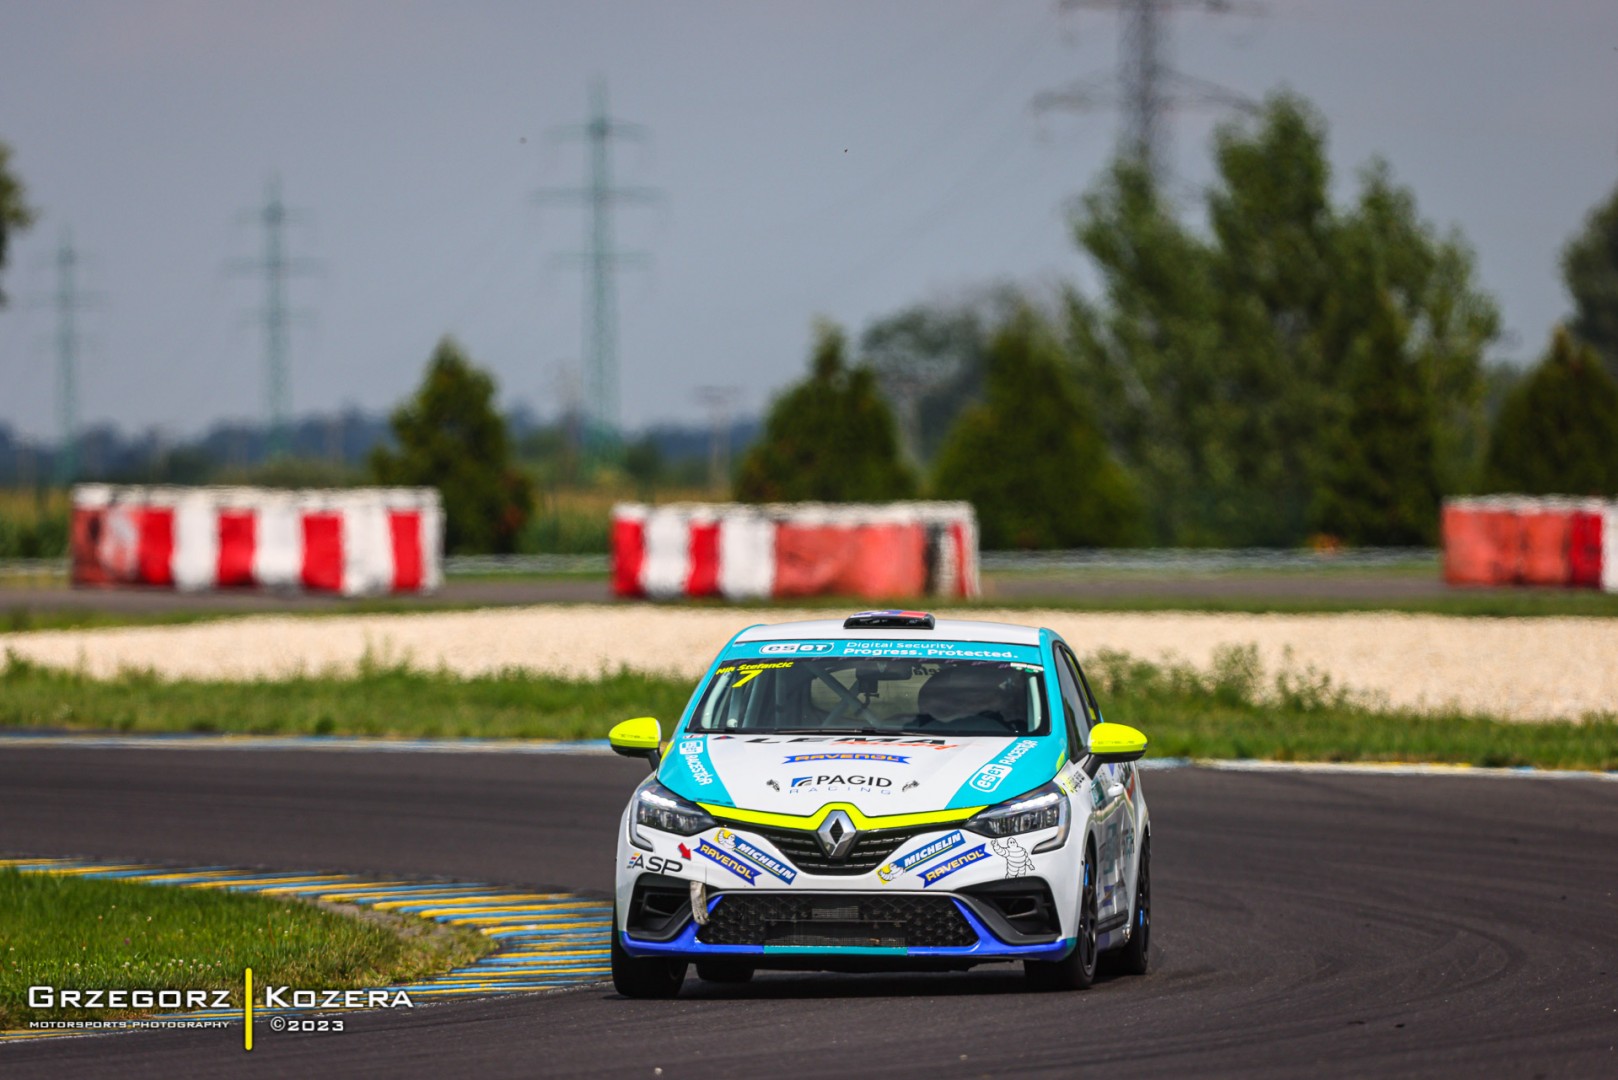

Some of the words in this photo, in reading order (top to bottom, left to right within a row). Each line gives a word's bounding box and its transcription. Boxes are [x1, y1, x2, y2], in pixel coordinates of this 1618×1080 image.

[843, 648, 923, 656] Progress.
[927, 649, 1018, 658] Protected.
[732, 669, 763, 688] 7
[794, 753, 901, 762] RAVENOL
[789, 786, 892, 795] RACING
[816, 775, 892, 788] PAGID
[903, 832, 962, 867] MICHELIN
[629, 854, 683, 874] ASP
[700, 844, 753, 879] RAVENOL
[737, 842, 795, 881] MICHELIN
[925, 850, 986, 882] RAVENOL
